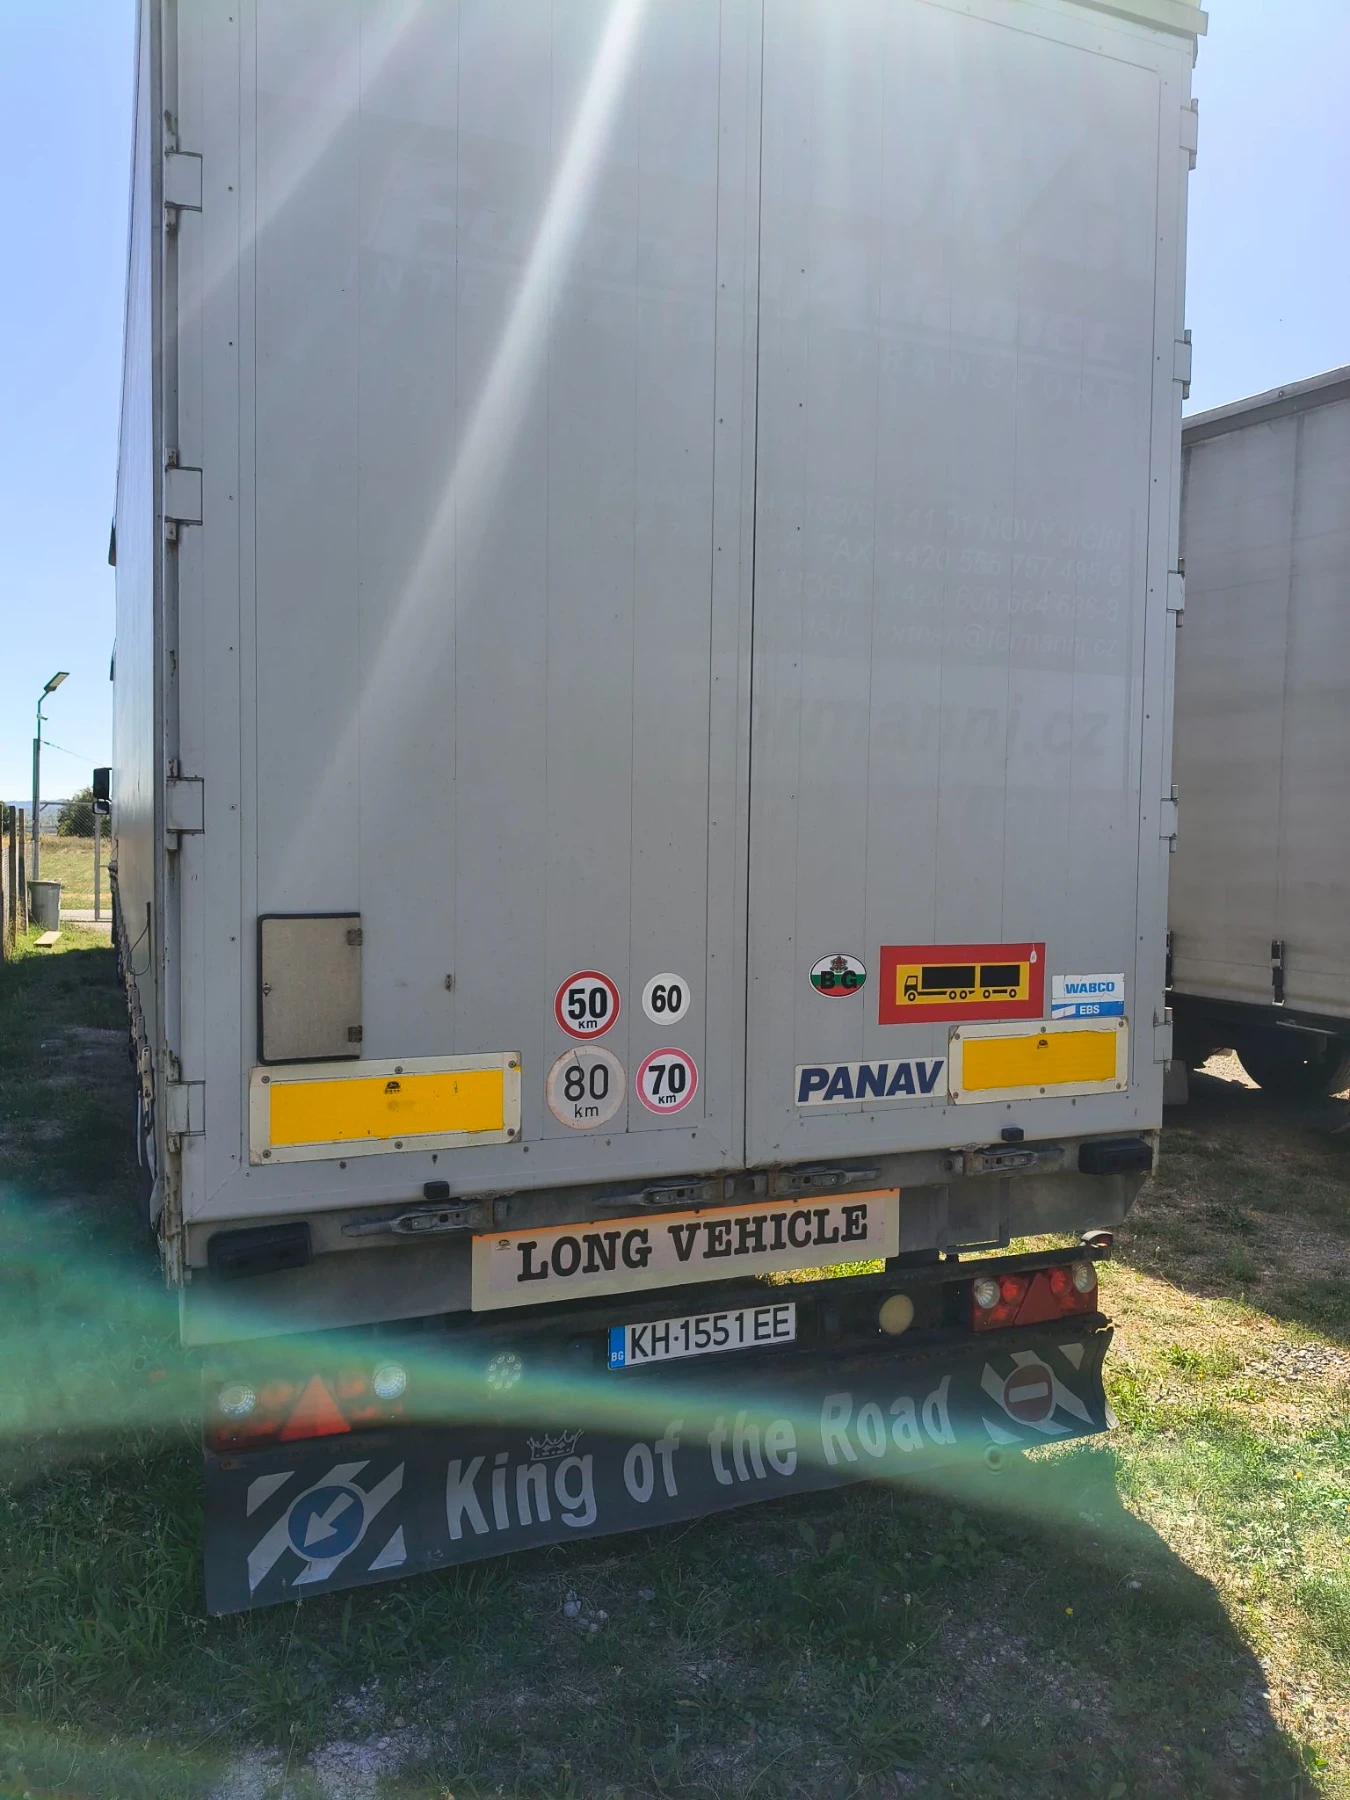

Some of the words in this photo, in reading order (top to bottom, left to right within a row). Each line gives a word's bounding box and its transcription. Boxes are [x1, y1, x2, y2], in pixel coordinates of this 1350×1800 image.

[820, 969, 858, 990] BG
[1065, 981, 1115, 995] WABCO
[567, 986, 608, 1021] 50
[651, 984, 682, 1014] 60
[1079, 1004, 1100, 1015] EBS
[564, 1063, 609, 1102] 80
[648, 1063, 686, 1096] 70
[797, 1060, 945, 1103] PANAV
[574, 1103, 599, 1119] km
[516, 1228, 653, 1282] LONG
[667, 1203, 868, 1262] VEHICLE
[611, 1350, 624, 1363] BG
[445, 1450, 599, 1541] King
[622, 1418, 685, 1503] of
[706, 1409, 797, 1486] the
[818, 1374, 958, 1466] Road
